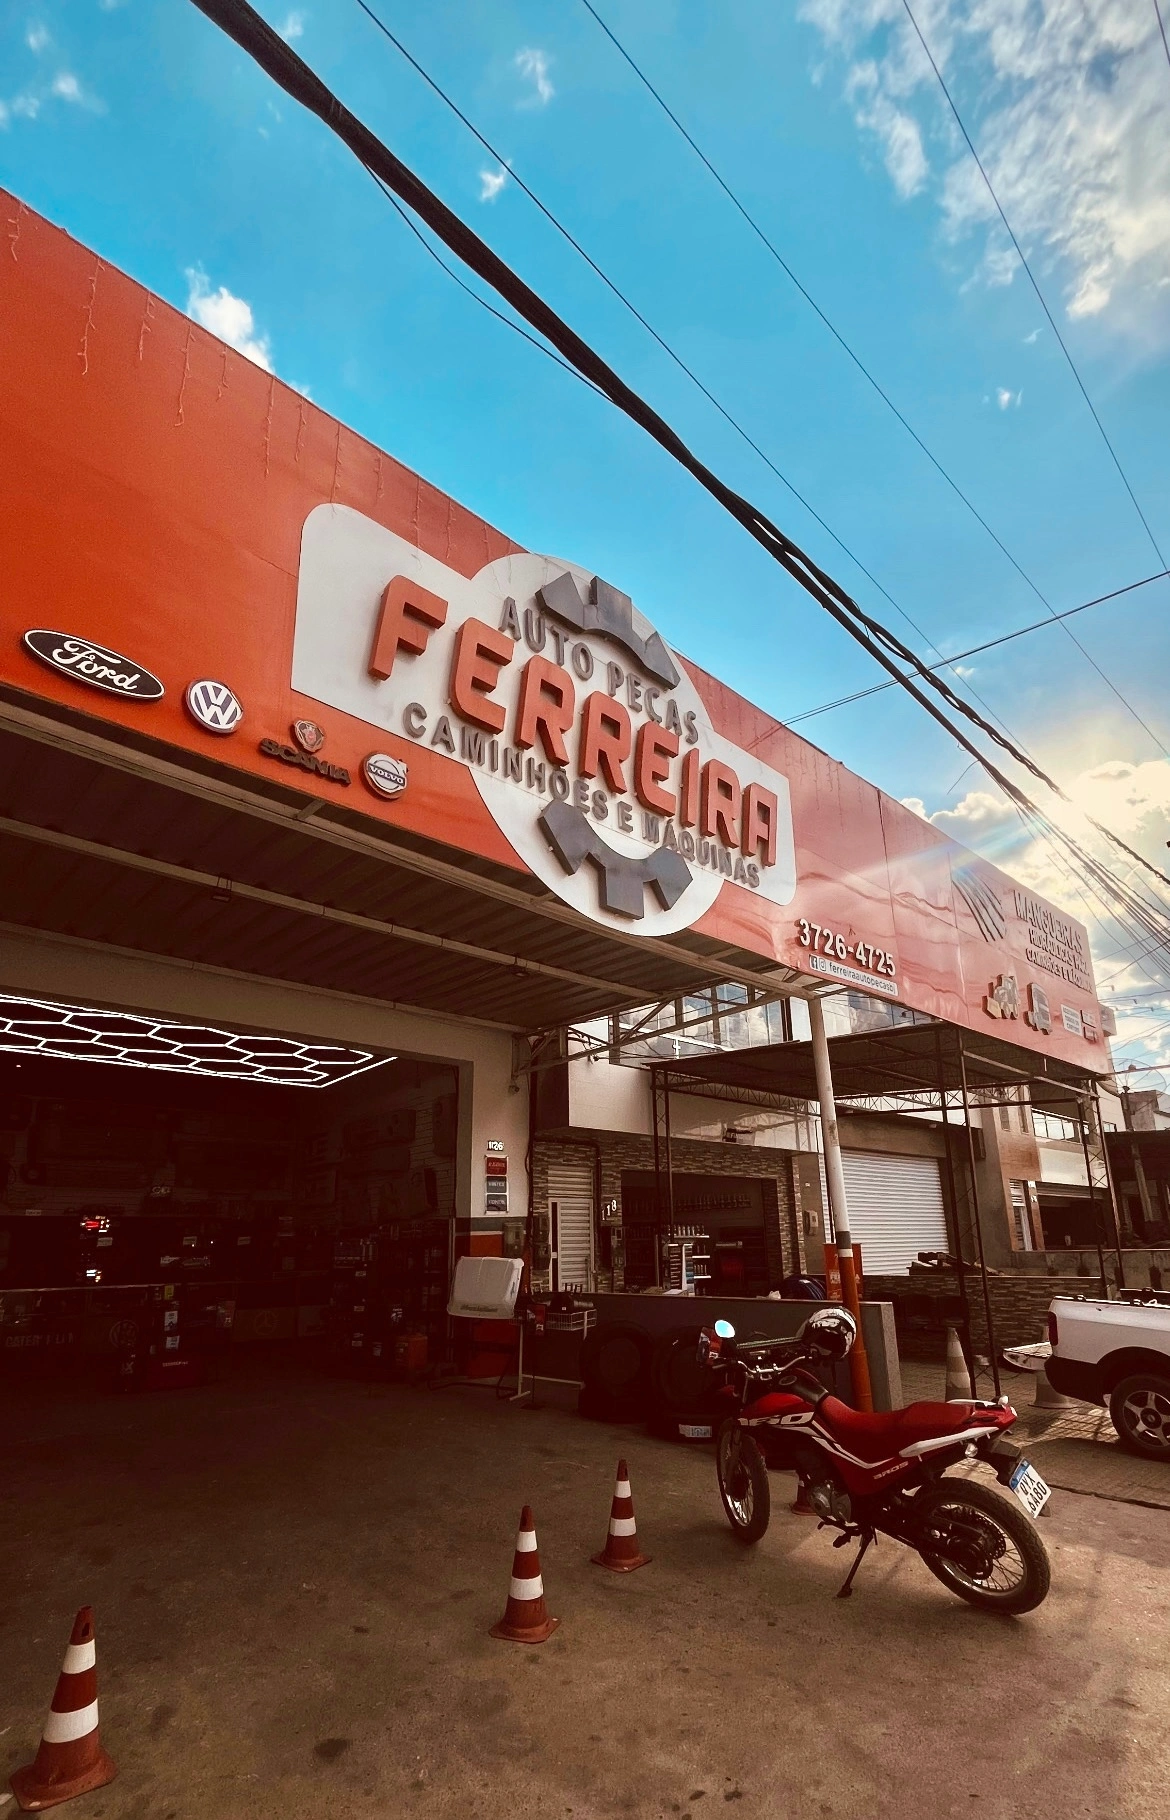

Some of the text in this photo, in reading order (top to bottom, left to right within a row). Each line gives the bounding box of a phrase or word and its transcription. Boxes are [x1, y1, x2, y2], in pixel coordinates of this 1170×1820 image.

[52, 640, 140, 690] Ford
[498, 596, 594, 681] AUTO
[367, 574, 778, 867] FERREIRA
[259, 737, 351, 786] SCANIA
[368, 764, 405, 786] VOLVO
[617, 801, 634, 833] E
[641, 811, 760, 888] MÁQUINAS
[799, 918, 896, 976] 3726-4725
[601, 1199, 617, 1221] 118
